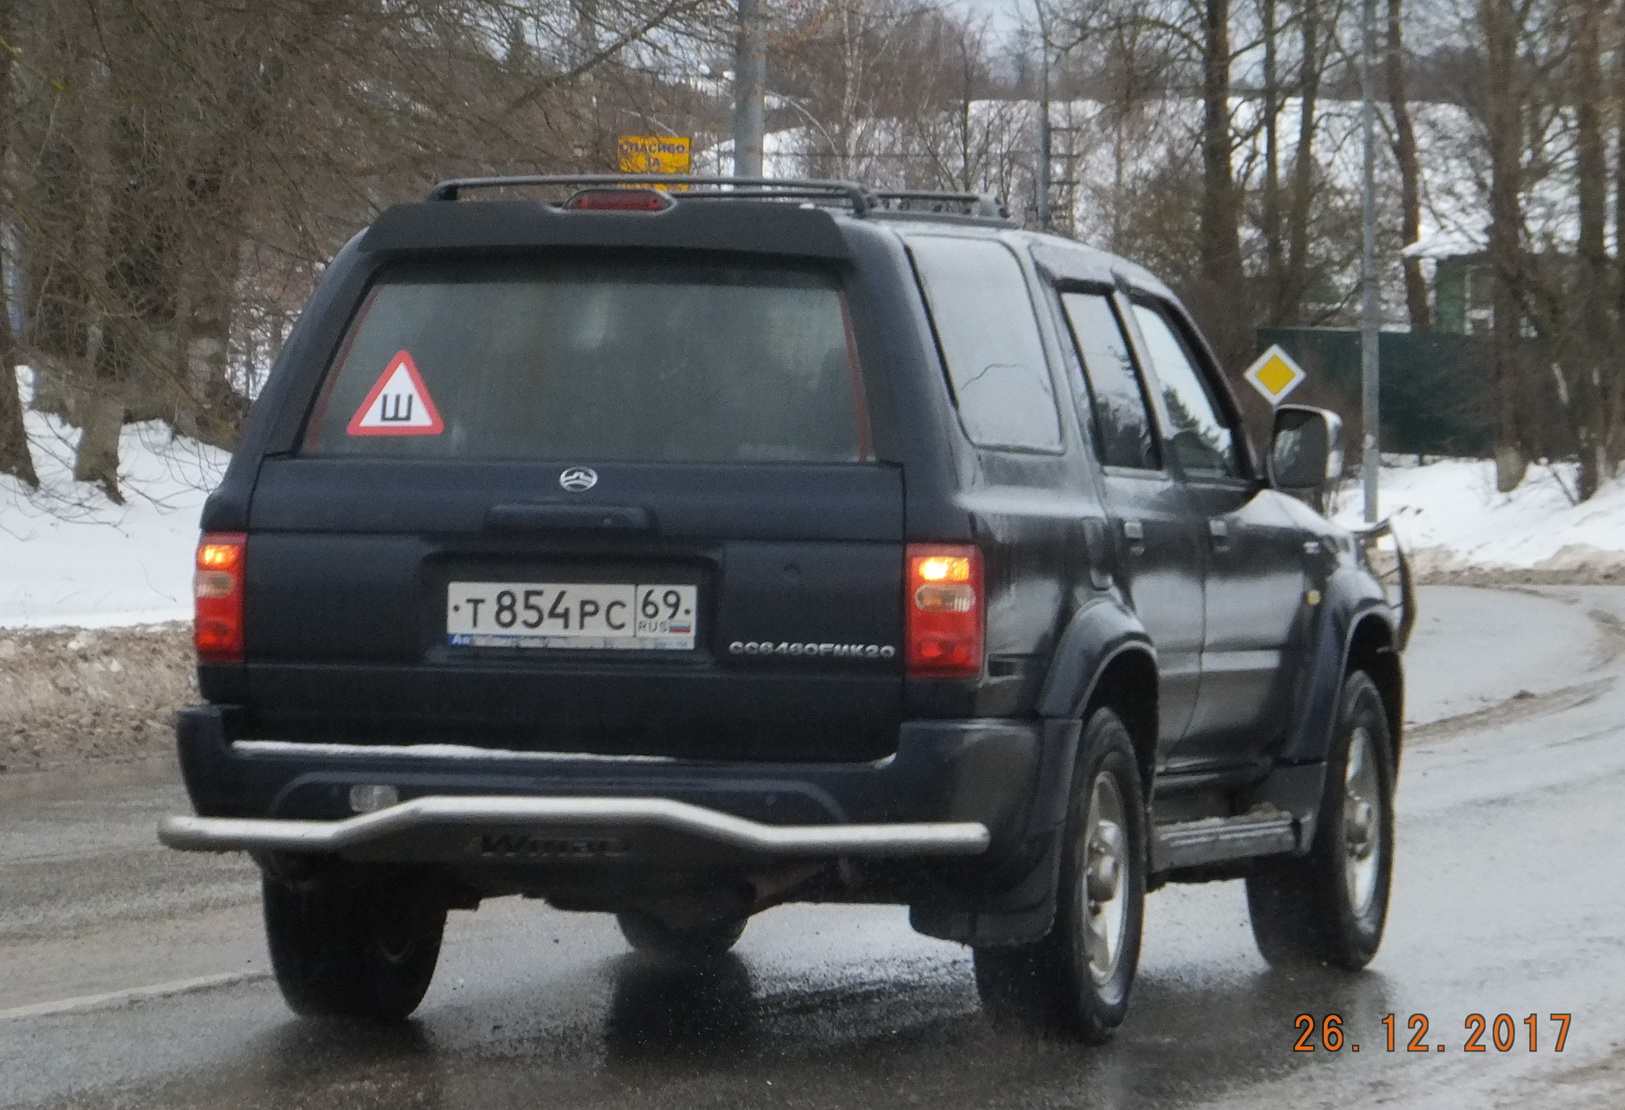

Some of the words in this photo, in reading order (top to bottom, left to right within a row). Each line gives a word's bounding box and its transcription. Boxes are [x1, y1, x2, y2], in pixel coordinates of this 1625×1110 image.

[381, 394, 413, 421] Ш
[641, 589, 681, 619] 69
[638, 621, 668, 632] RUS
